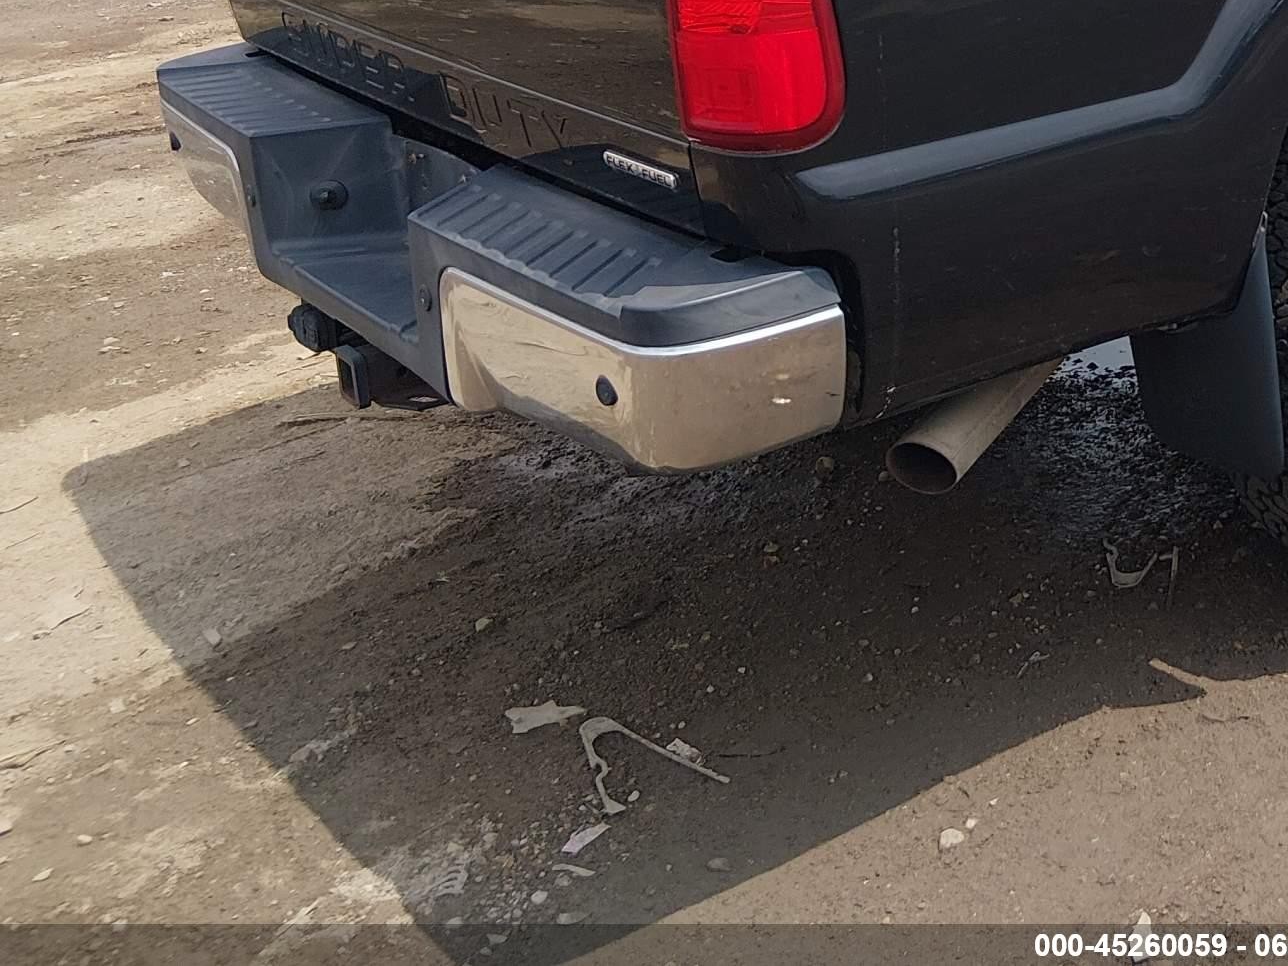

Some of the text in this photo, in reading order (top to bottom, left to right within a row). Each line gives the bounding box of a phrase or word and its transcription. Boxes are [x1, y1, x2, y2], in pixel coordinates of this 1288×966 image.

[439, 70, 569, 149] DUTY
[606, 154, 672, 187] FLEX FUEL
